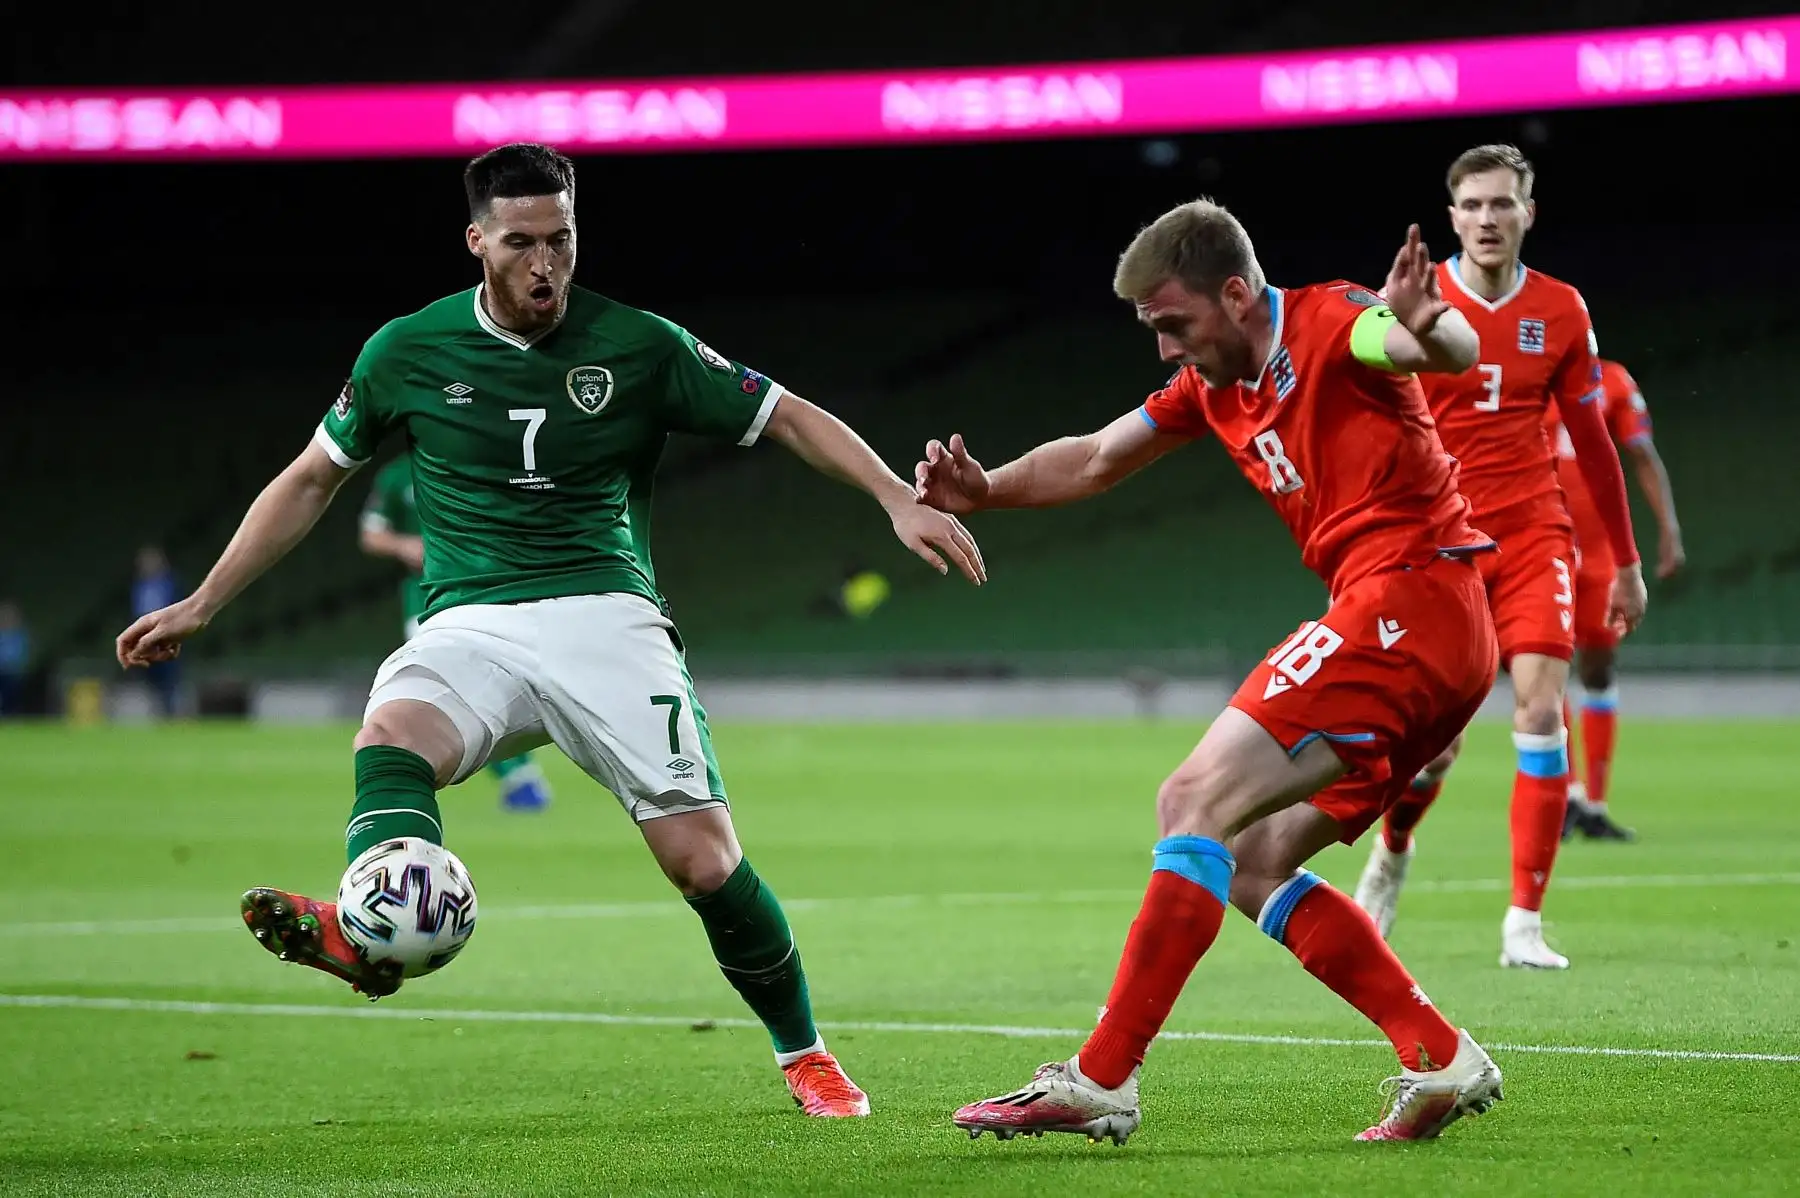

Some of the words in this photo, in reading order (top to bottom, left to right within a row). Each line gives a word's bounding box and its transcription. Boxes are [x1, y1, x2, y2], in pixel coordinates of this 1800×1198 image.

[1260, 54, 1458, 112] NISSAN
[1577, 31, 1786, 93] NISSAN
[0, 97, 282, 151] NISSAN
[453, 87, 726, 147] NISSAN
[881, 73, 1123, 131] NISSAN
[446, 397, 473, 405] umbro
[576, 373, 604, 383] Ireland
[1473, 363, 1503, 412] 3
[508, 408, 547, 470] 7
[1254, 428, 1305, 495] 8
[1267, 620, 1345, 687] 18
[649, 694, 681, 755] 7
[672, 771, 695, 780] umbro
